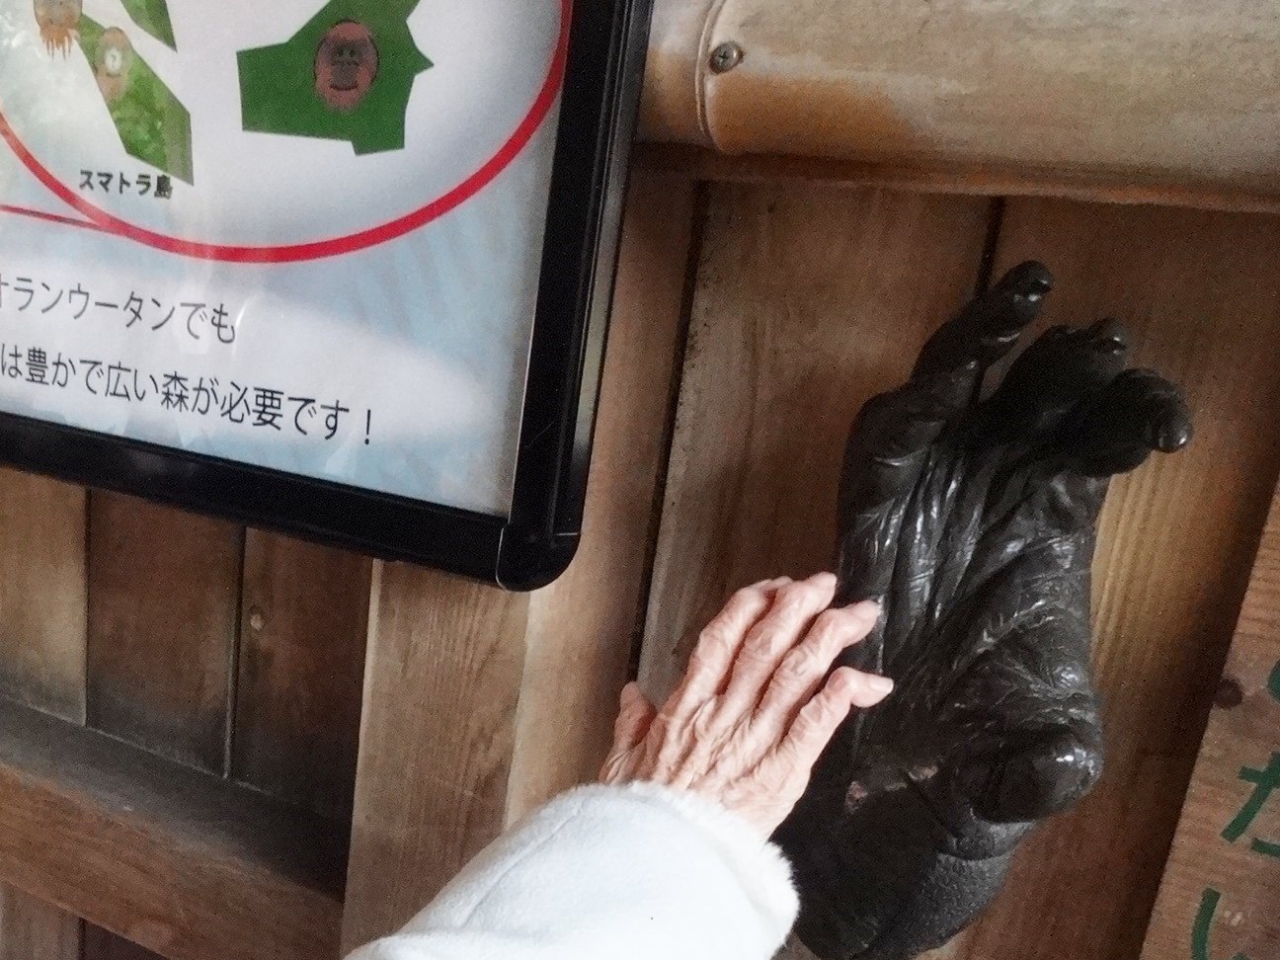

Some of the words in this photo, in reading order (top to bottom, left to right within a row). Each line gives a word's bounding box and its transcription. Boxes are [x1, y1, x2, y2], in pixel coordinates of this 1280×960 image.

[79, 168, 173, 200] スマトラ島
